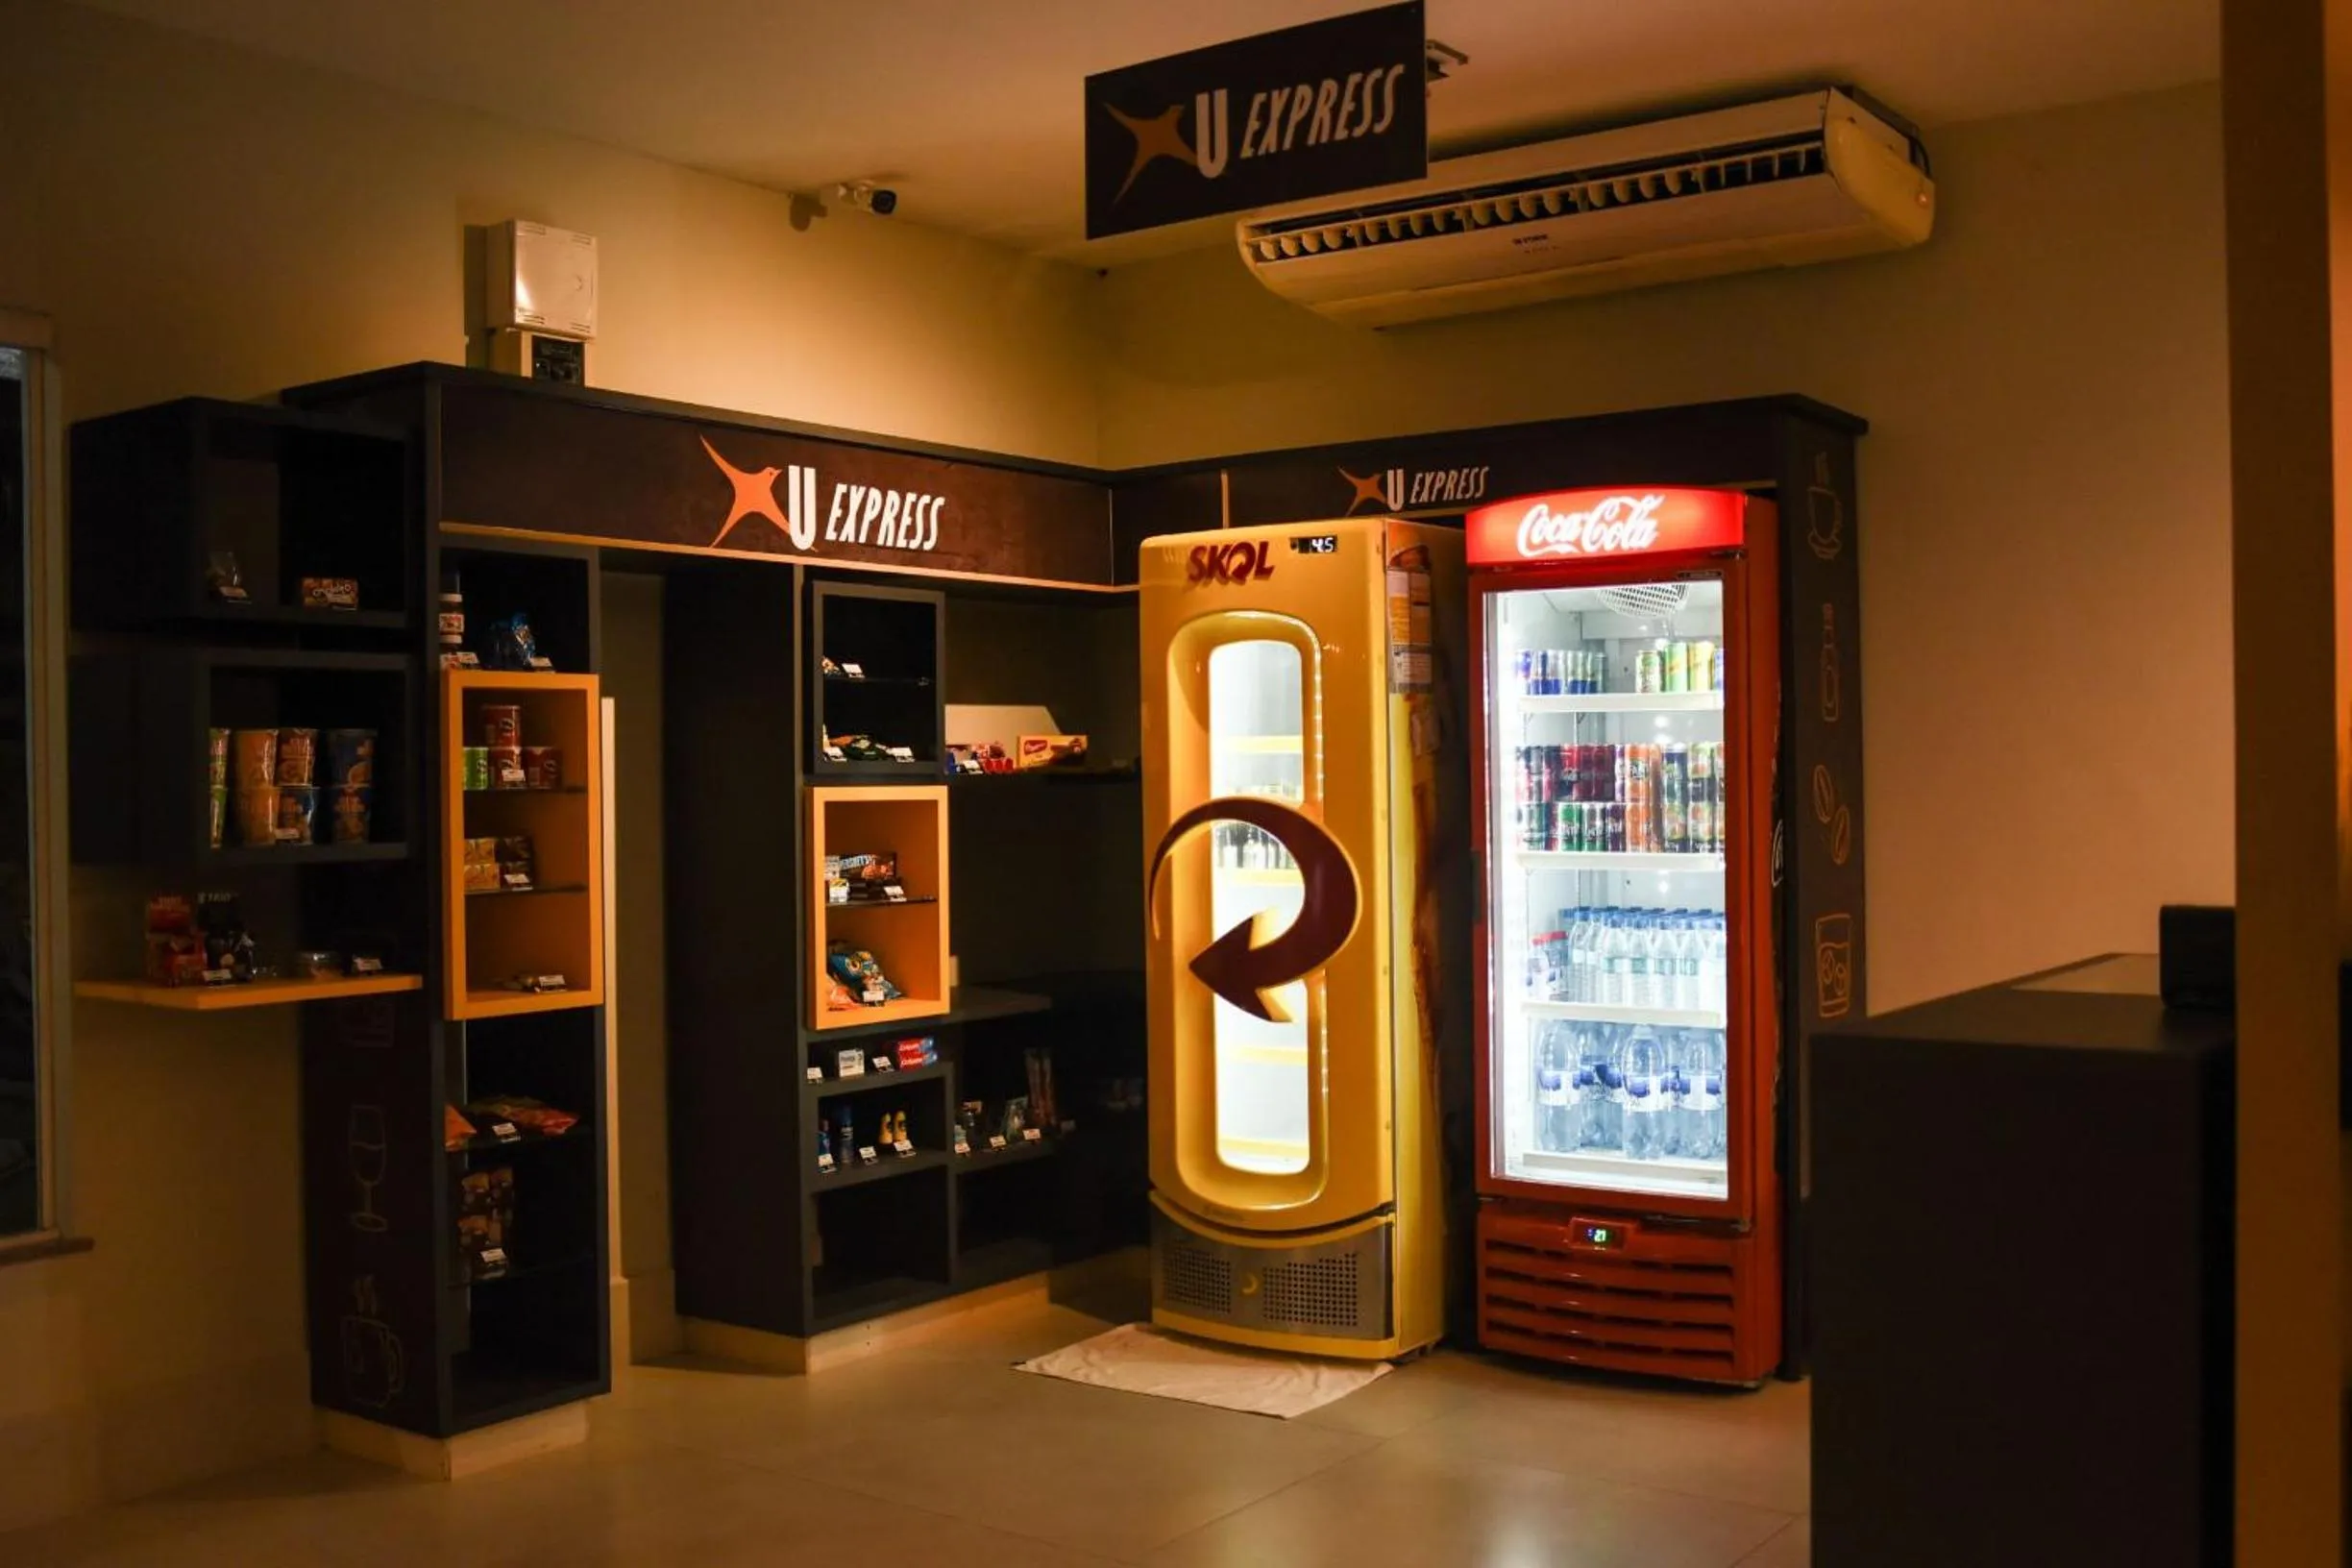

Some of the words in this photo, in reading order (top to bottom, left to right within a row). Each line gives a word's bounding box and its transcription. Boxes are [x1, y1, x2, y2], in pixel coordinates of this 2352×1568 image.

[1239, 63, 1406, 159] EXPRESS
[824, 482, 946, 551] EXPRESS
[1409, 465, 1489, 505] EXPRESS
[1515, 494, 1666, 558] Coca-Cola
[1188, 540, 1276, 585] SKOL
